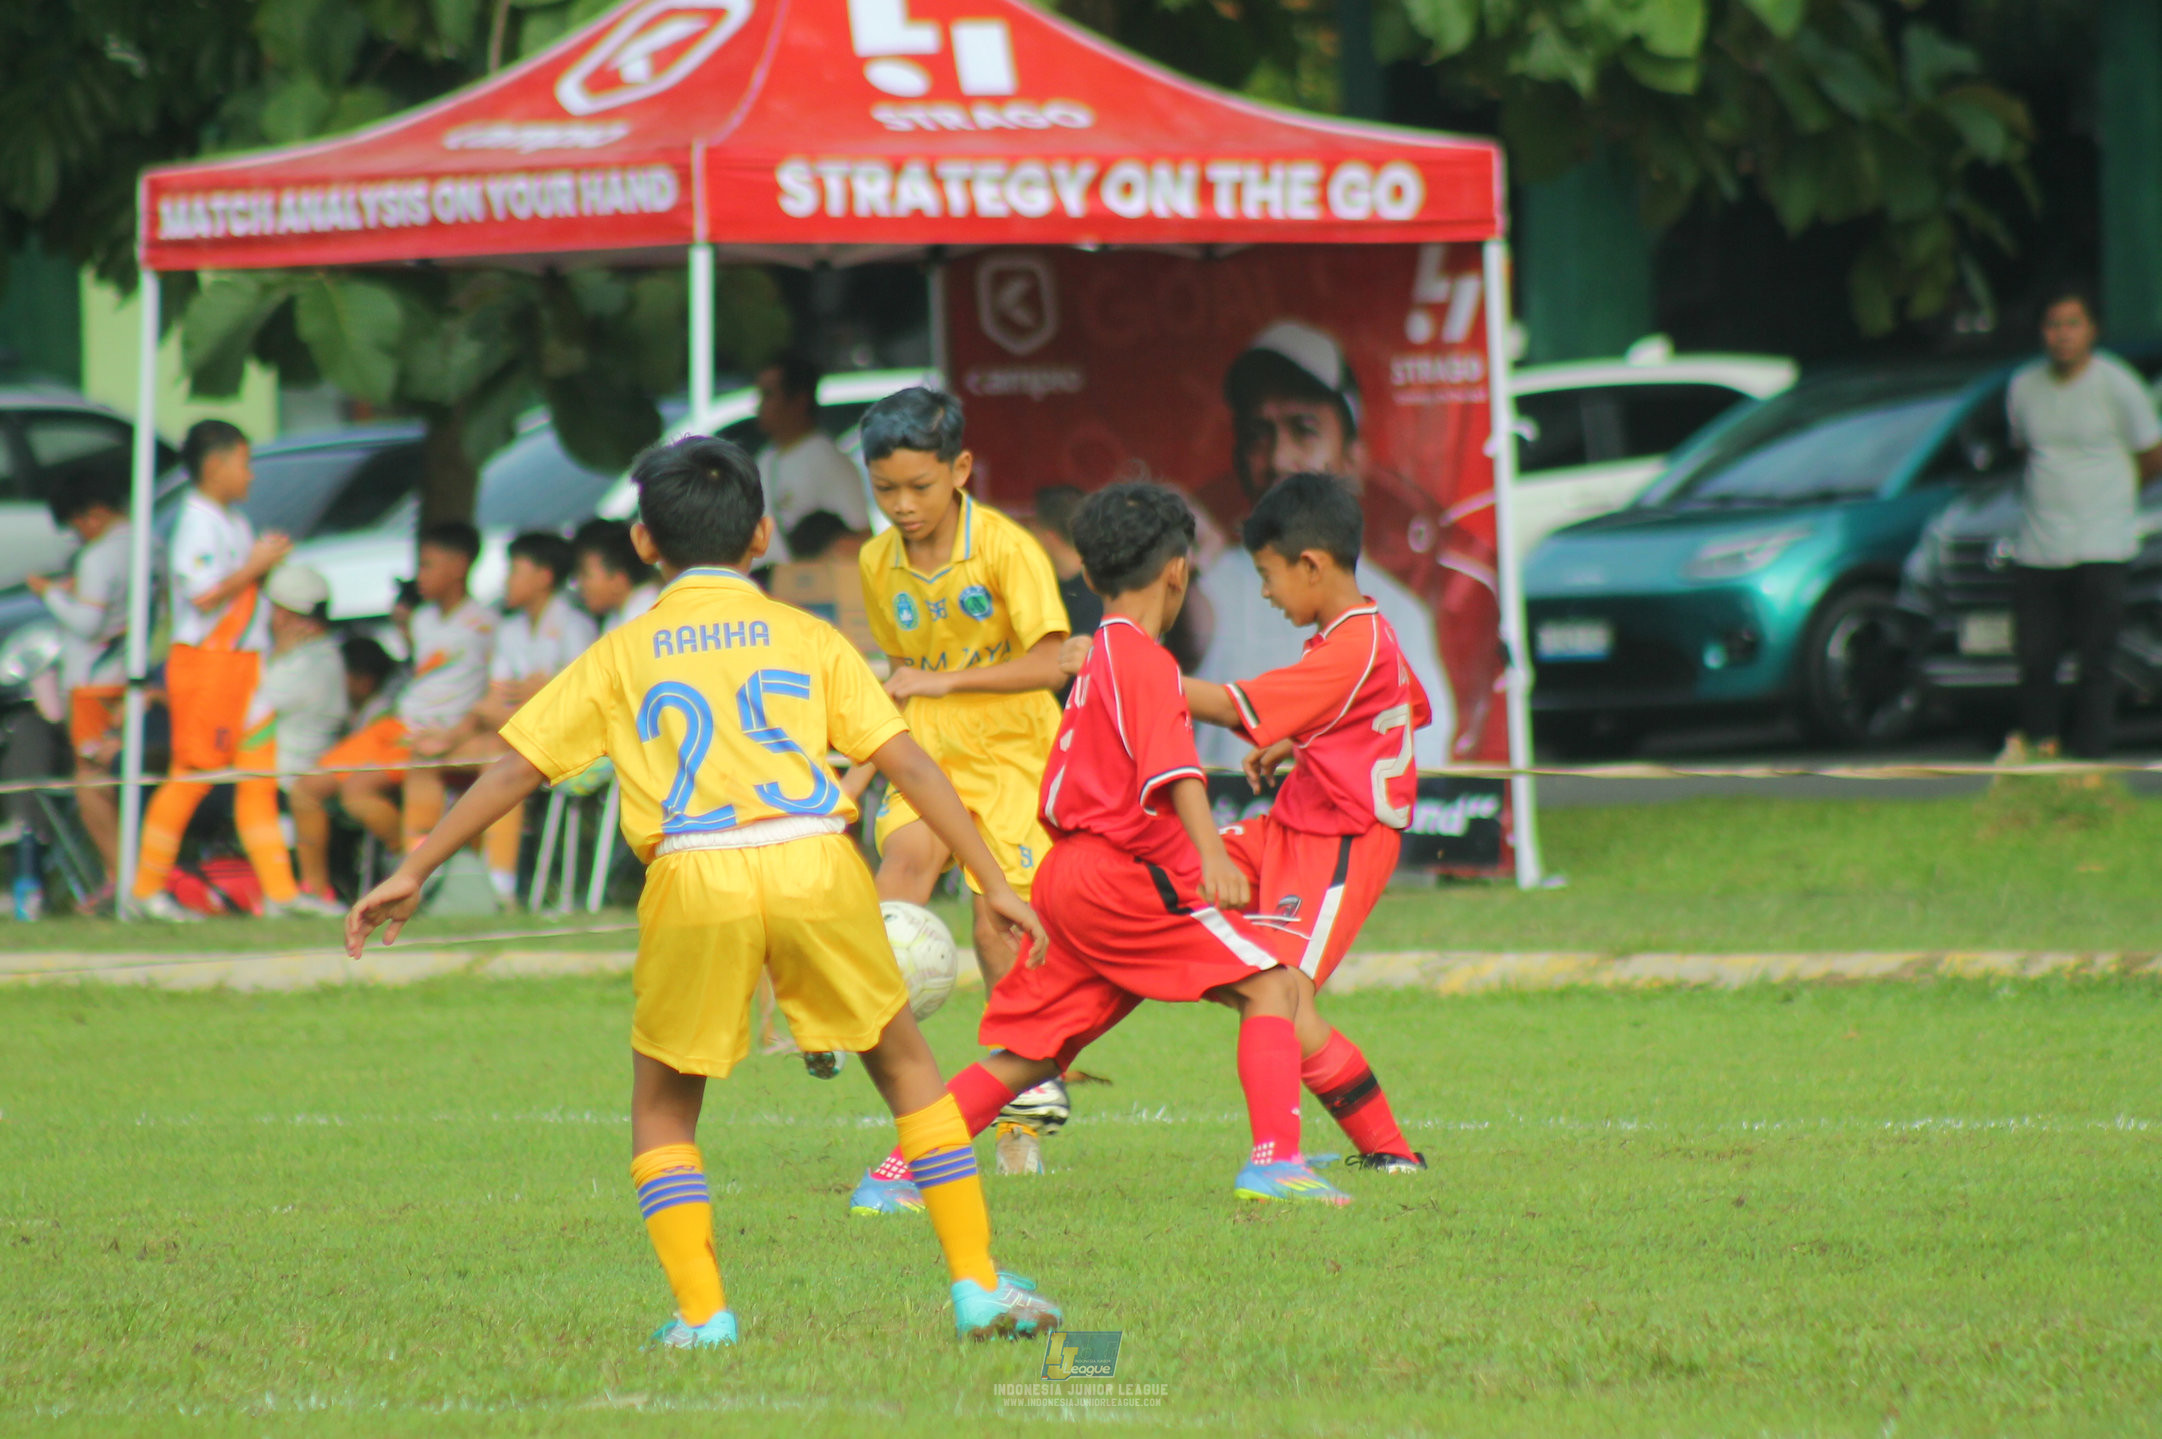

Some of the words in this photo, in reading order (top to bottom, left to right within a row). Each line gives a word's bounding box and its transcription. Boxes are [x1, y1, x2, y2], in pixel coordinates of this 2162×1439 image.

[870, 100, 1096, 132] STRAGO
[157, 190, 276, 240] MATCH
[276, 173, 432, 235] ANALYSIS
[432, 175, 486, 225] ON
[484, 168, 578, 222] YOUR
[577, 163, 680, 217] HAND
[775, 155, 1098, 218] STRATEGY
[1100, 157, 1200, 219] ON
[1205, 157, 1323, 220] THE
[1326, 158, 1427, 221] GO
[1390, 354, 1484, 386] STRAGO
[653, 620, 770, 658] RAKHA
[636, 669, 840, 833] 25
